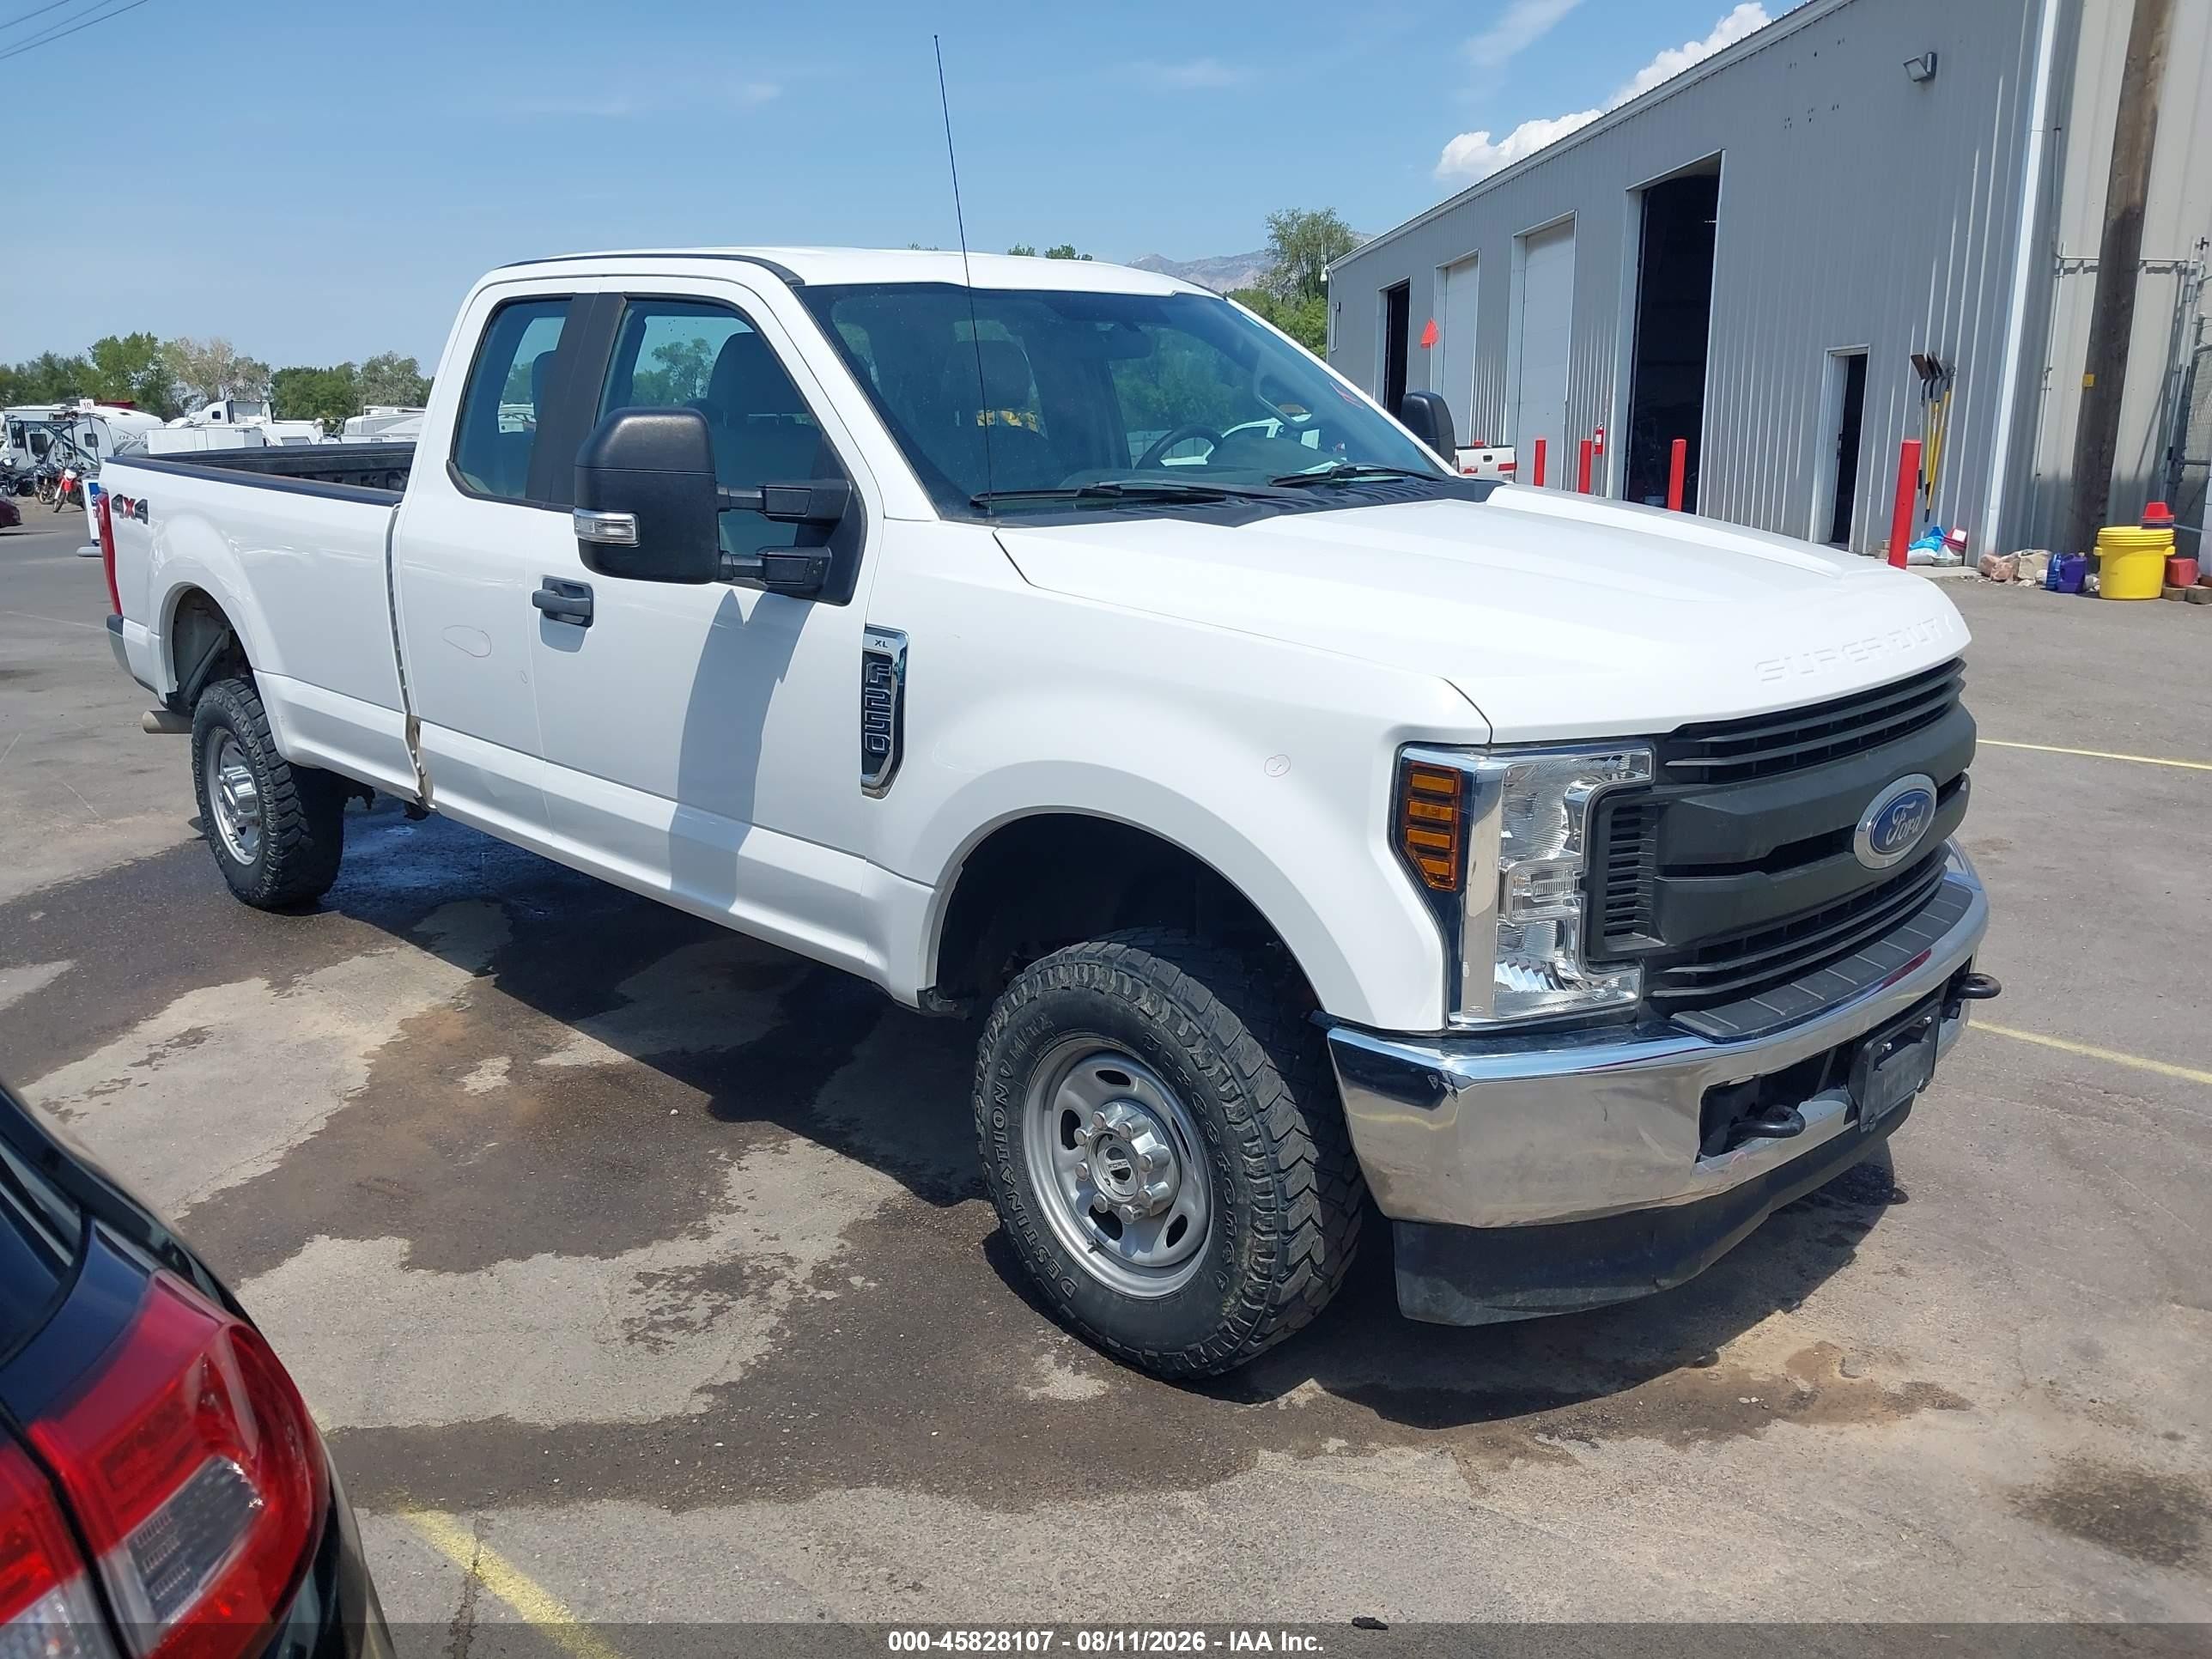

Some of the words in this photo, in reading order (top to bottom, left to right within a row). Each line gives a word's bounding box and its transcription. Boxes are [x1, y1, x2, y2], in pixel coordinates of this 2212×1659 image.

[83, 402, 92, 410] 10
[874, 639, 889, 648] XL
[1753, 636, 1893, 684] SUPER
[1886, 799, 1925, 846] Ford
[1109, 1160, 1127, 1169] FORD
[991, 1084, 1076, 1300] DESTINATION
